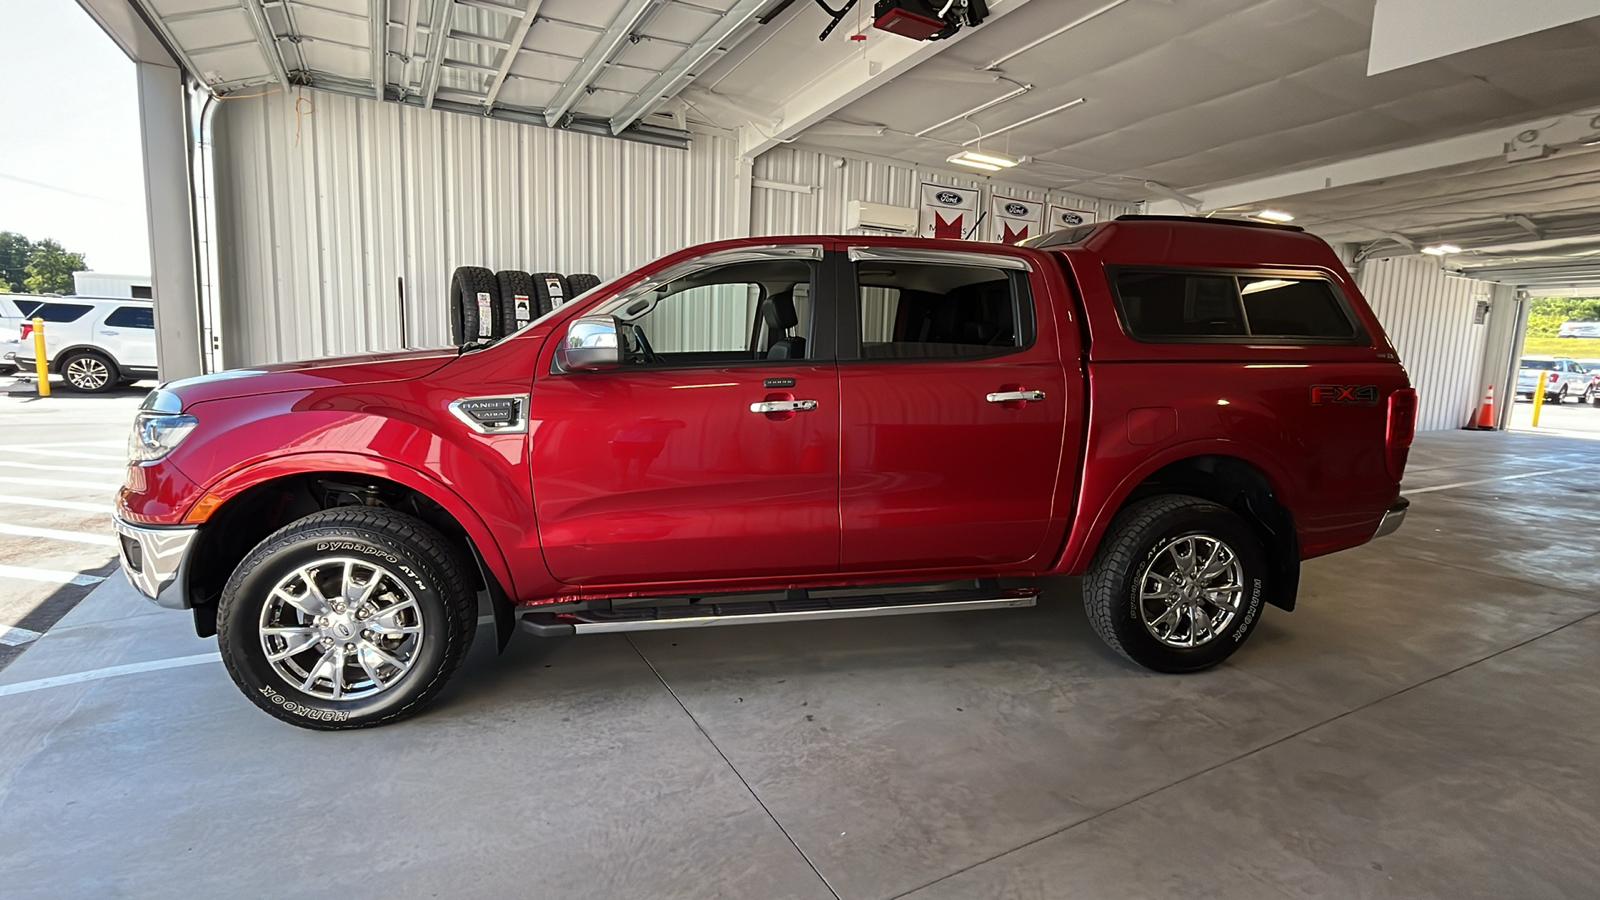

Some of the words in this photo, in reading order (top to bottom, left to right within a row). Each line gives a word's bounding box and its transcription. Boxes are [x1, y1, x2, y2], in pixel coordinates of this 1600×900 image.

[939, 191, 959, 204] Ford
[1008, 203, 1025, 215] Ford
[1065, 213, 1080, 224] Ford
[1309, 384, 1379, 406] FX4
